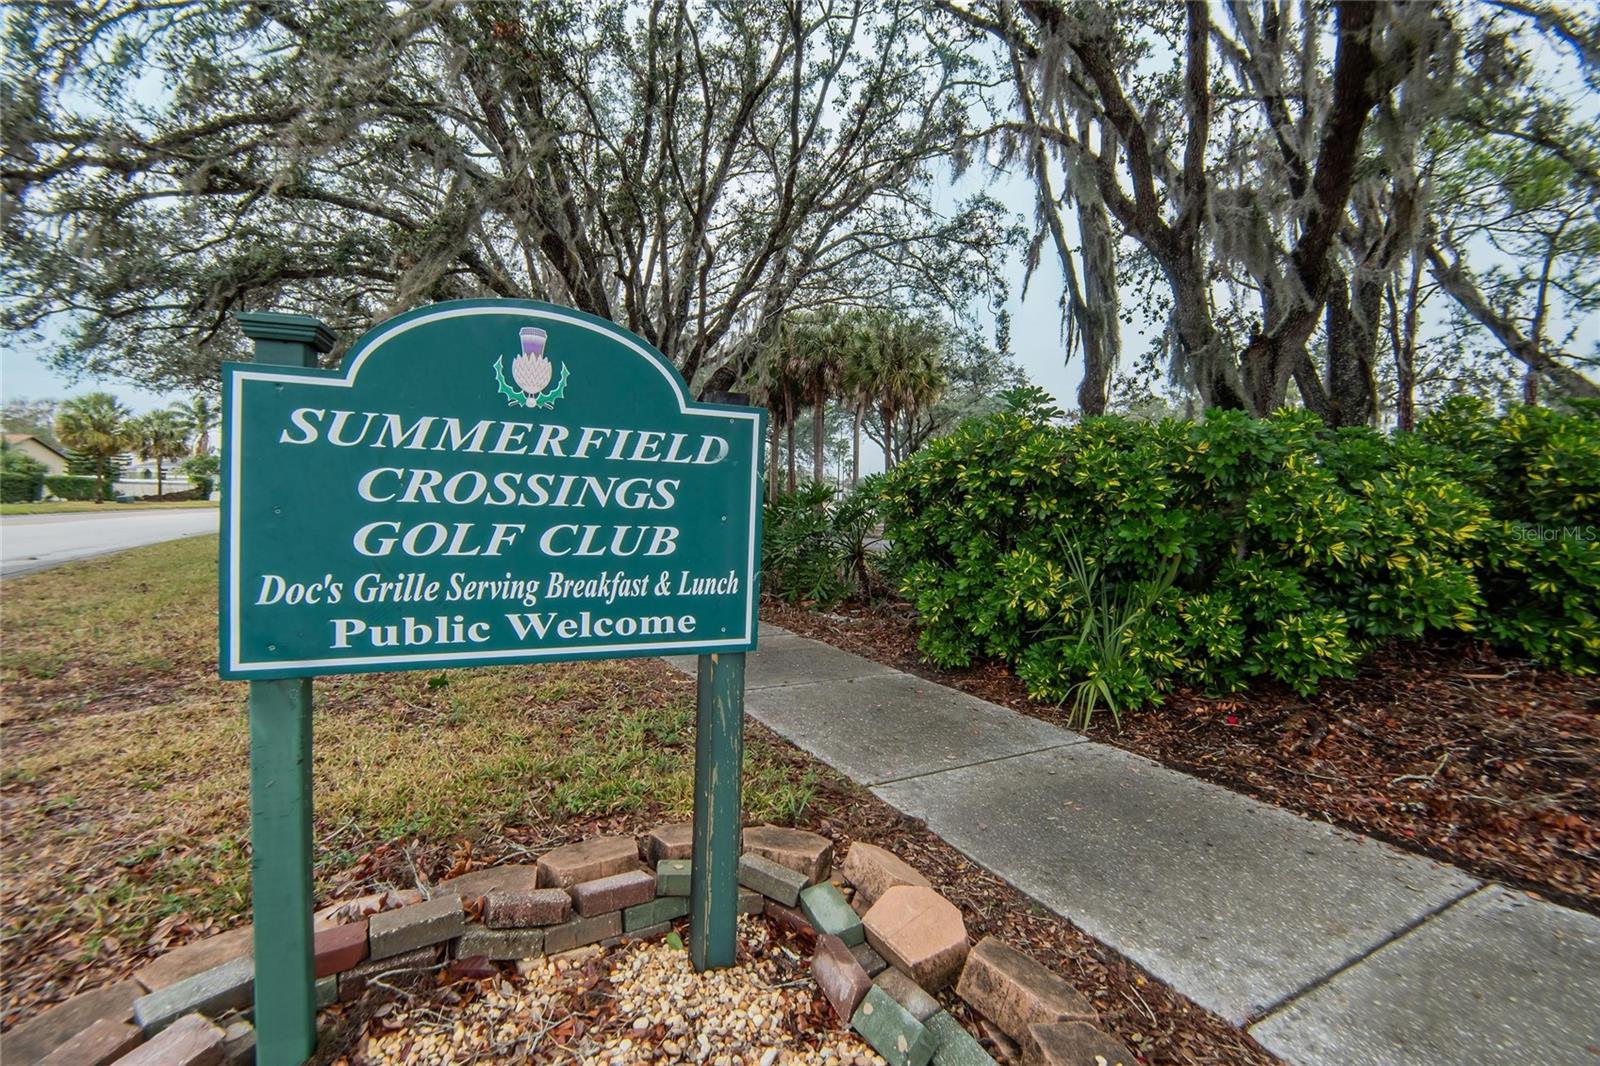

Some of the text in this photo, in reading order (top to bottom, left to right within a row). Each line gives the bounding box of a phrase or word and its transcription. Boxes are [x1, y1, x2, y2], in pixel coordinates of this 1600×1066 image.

[279, 407, 729, 465] SUMMERFIELD
[357, 467, 681, 510] CROSSINGS
[352, 521, 680, 557] GOLF CLUB
[255, 570, 739, 607] Doc's Grille Serving Breakfast & Lunch
[330, 611, 697, 648] Public Welcome
